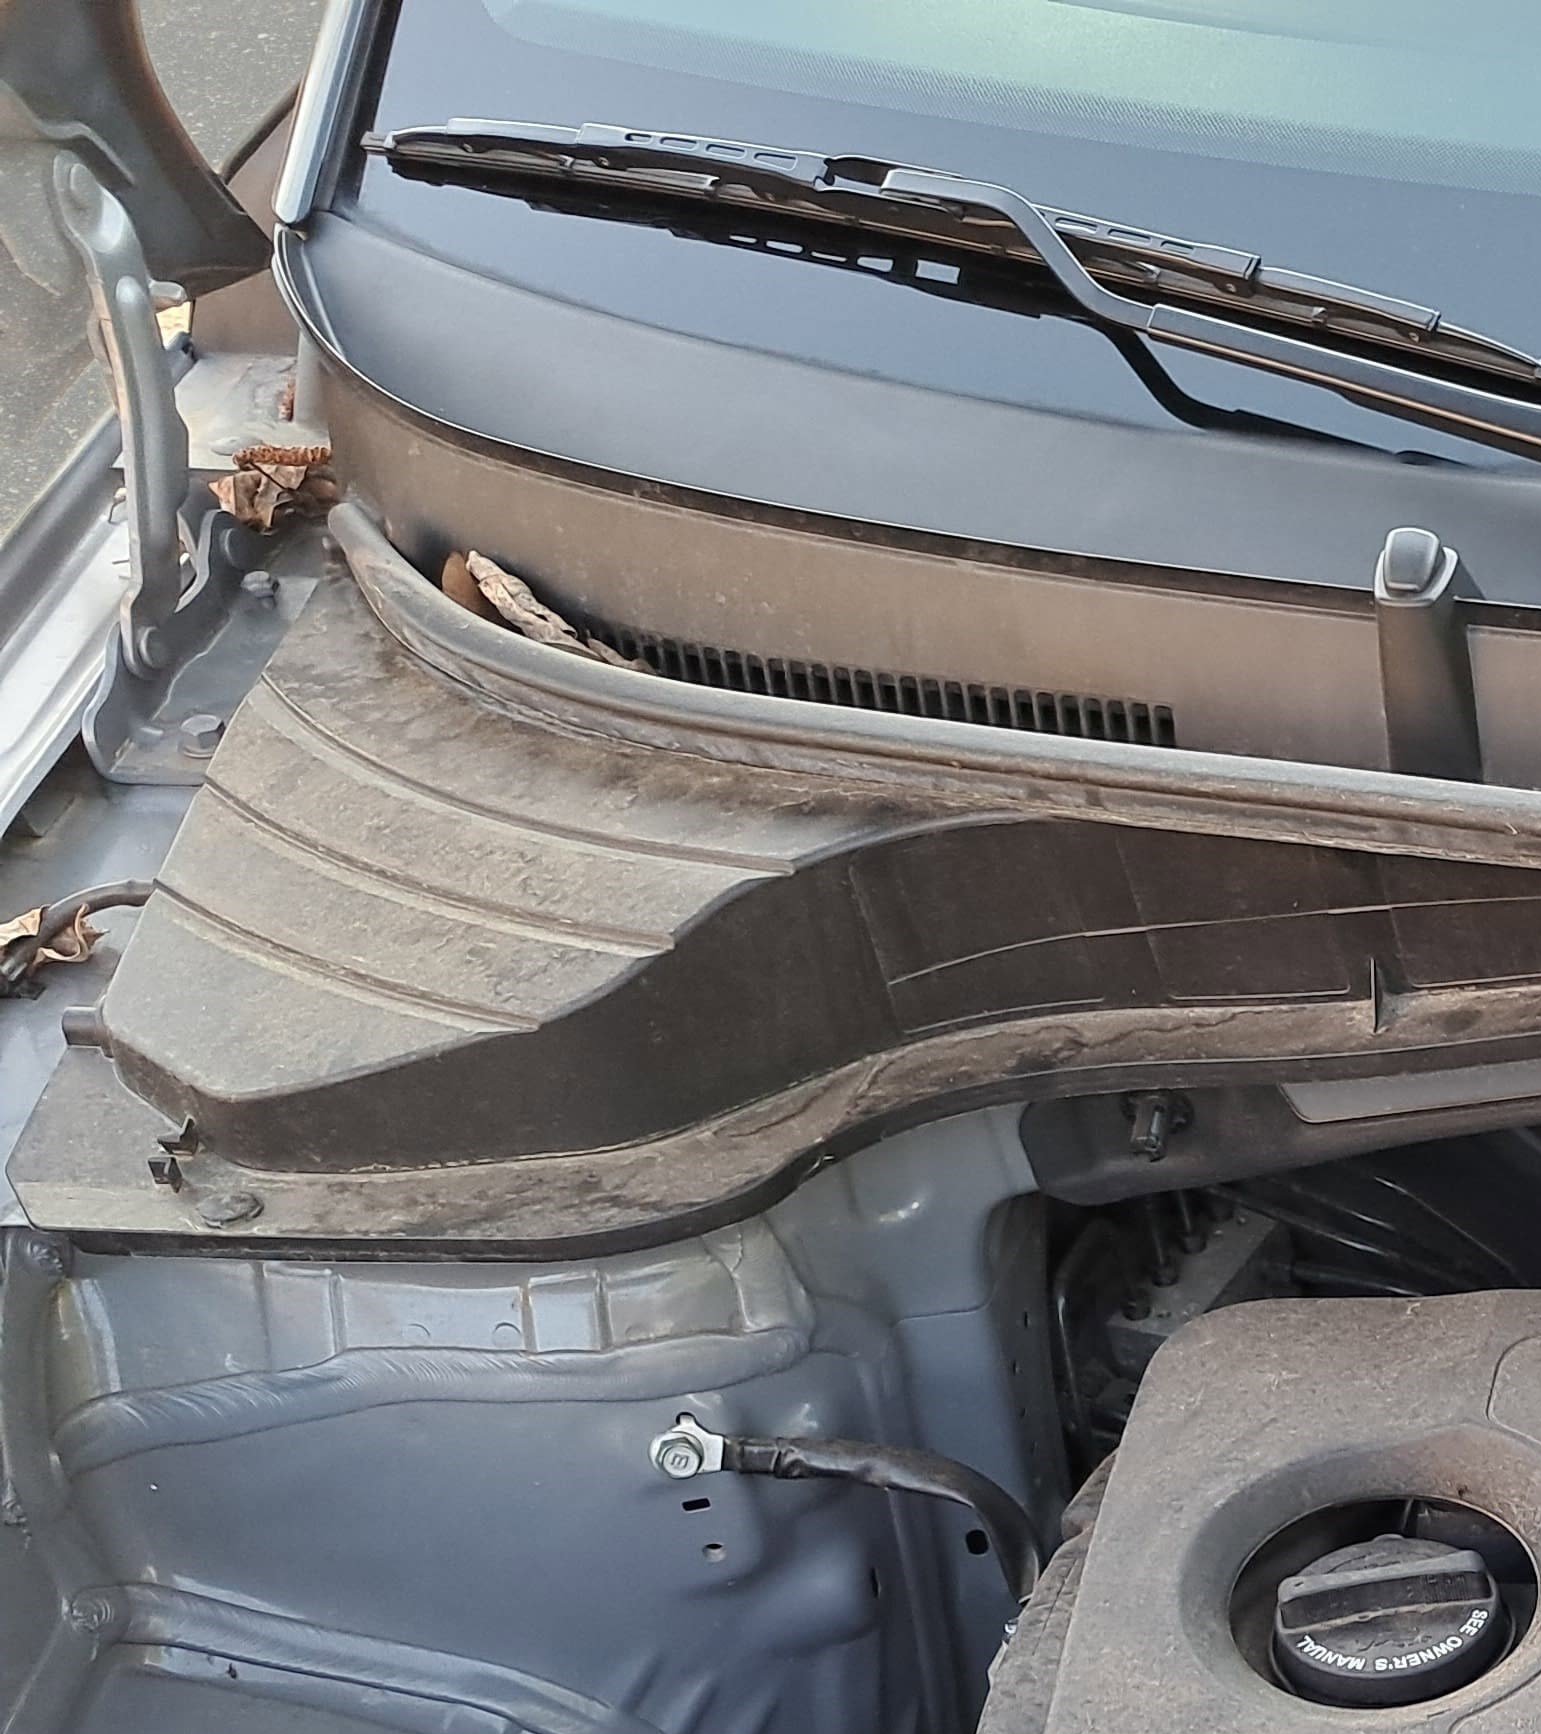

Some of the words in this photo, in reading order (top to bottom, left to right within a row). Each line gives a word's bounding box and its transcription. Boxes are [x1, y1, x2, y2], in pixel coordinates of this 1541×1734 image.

[1460, 1608, 1488, 1636] SEE
[1297, 1635, 1365, 1671] MANUAL
[1375, 1635, 1463, 1672] OWNER'S
